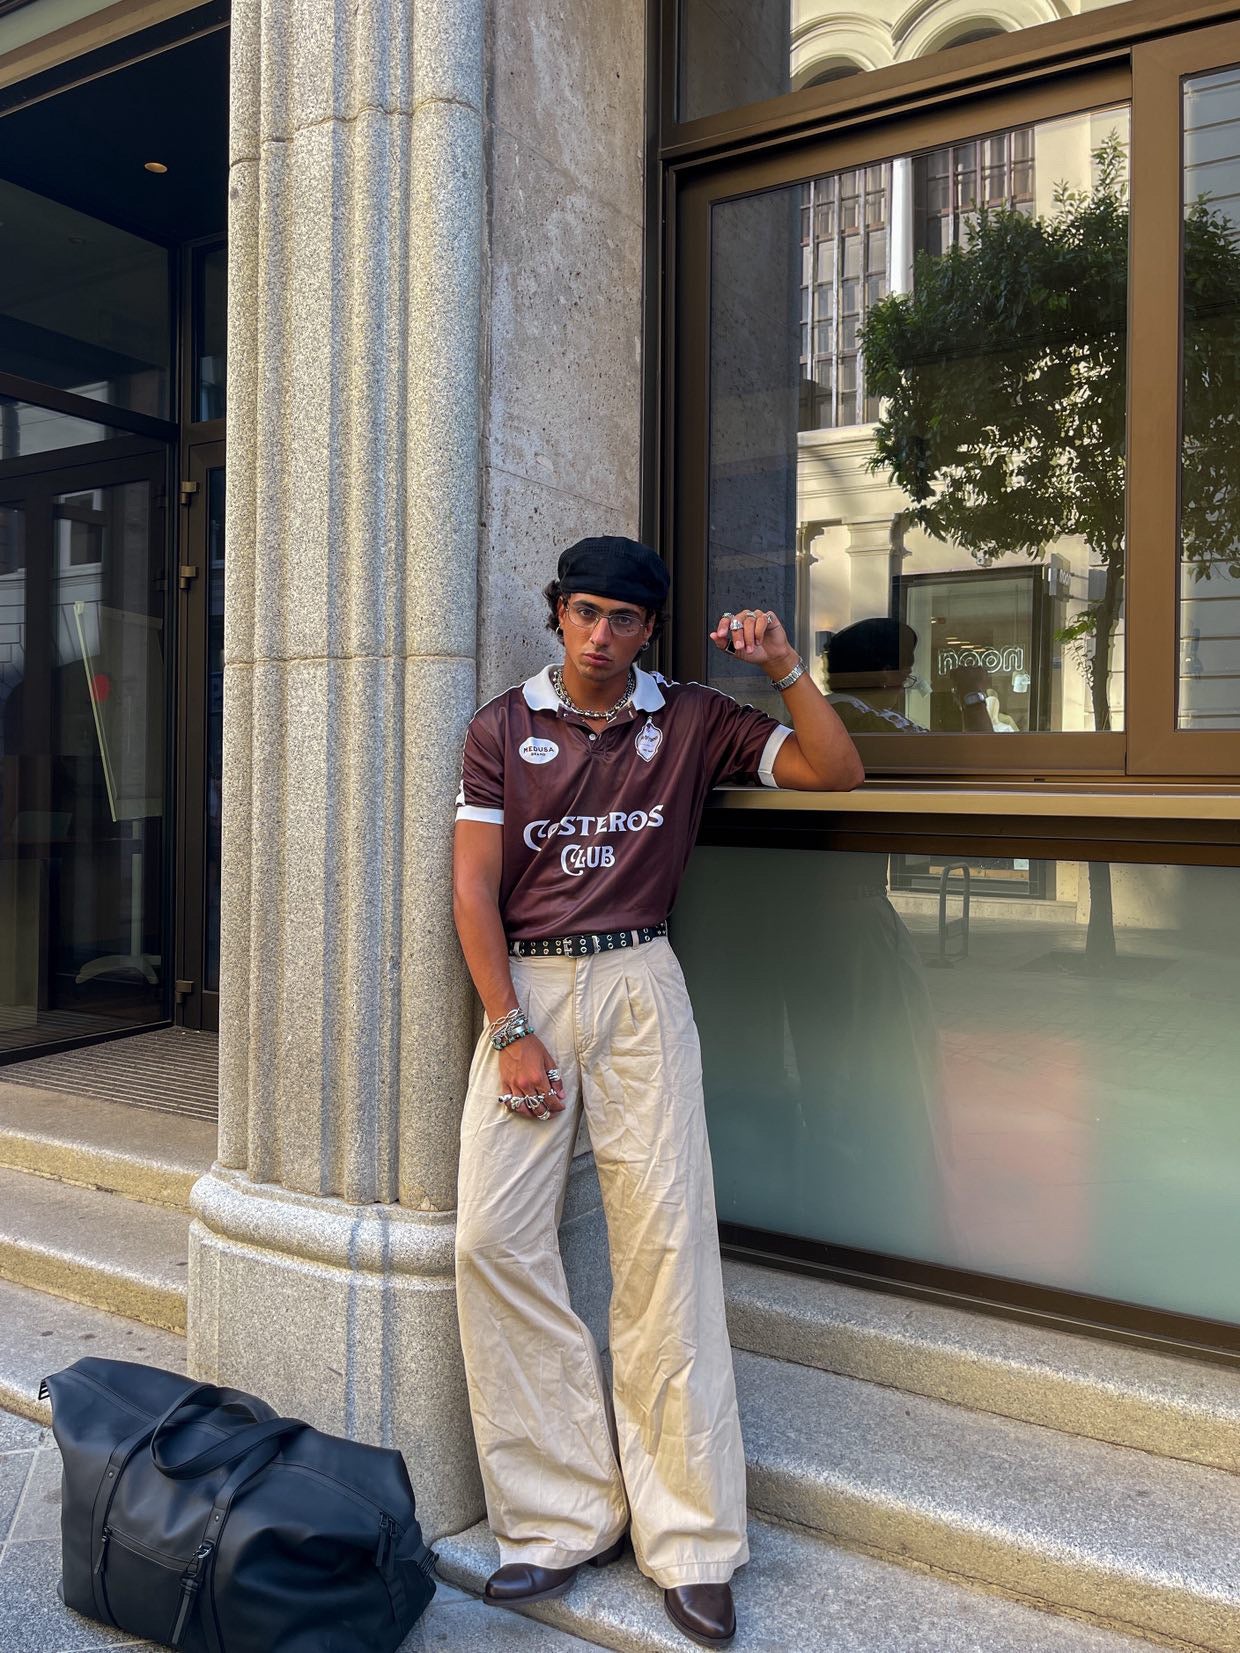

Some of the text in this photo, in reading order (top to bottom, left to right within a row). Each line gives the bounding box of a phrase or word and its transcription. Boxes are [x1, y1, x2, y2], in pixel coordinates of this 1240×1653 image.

[523, 745, 555, 754] MEDUSA
[523, 804, 664, 852] COSTEROS
[560, 844, 616, 877] CLUB
